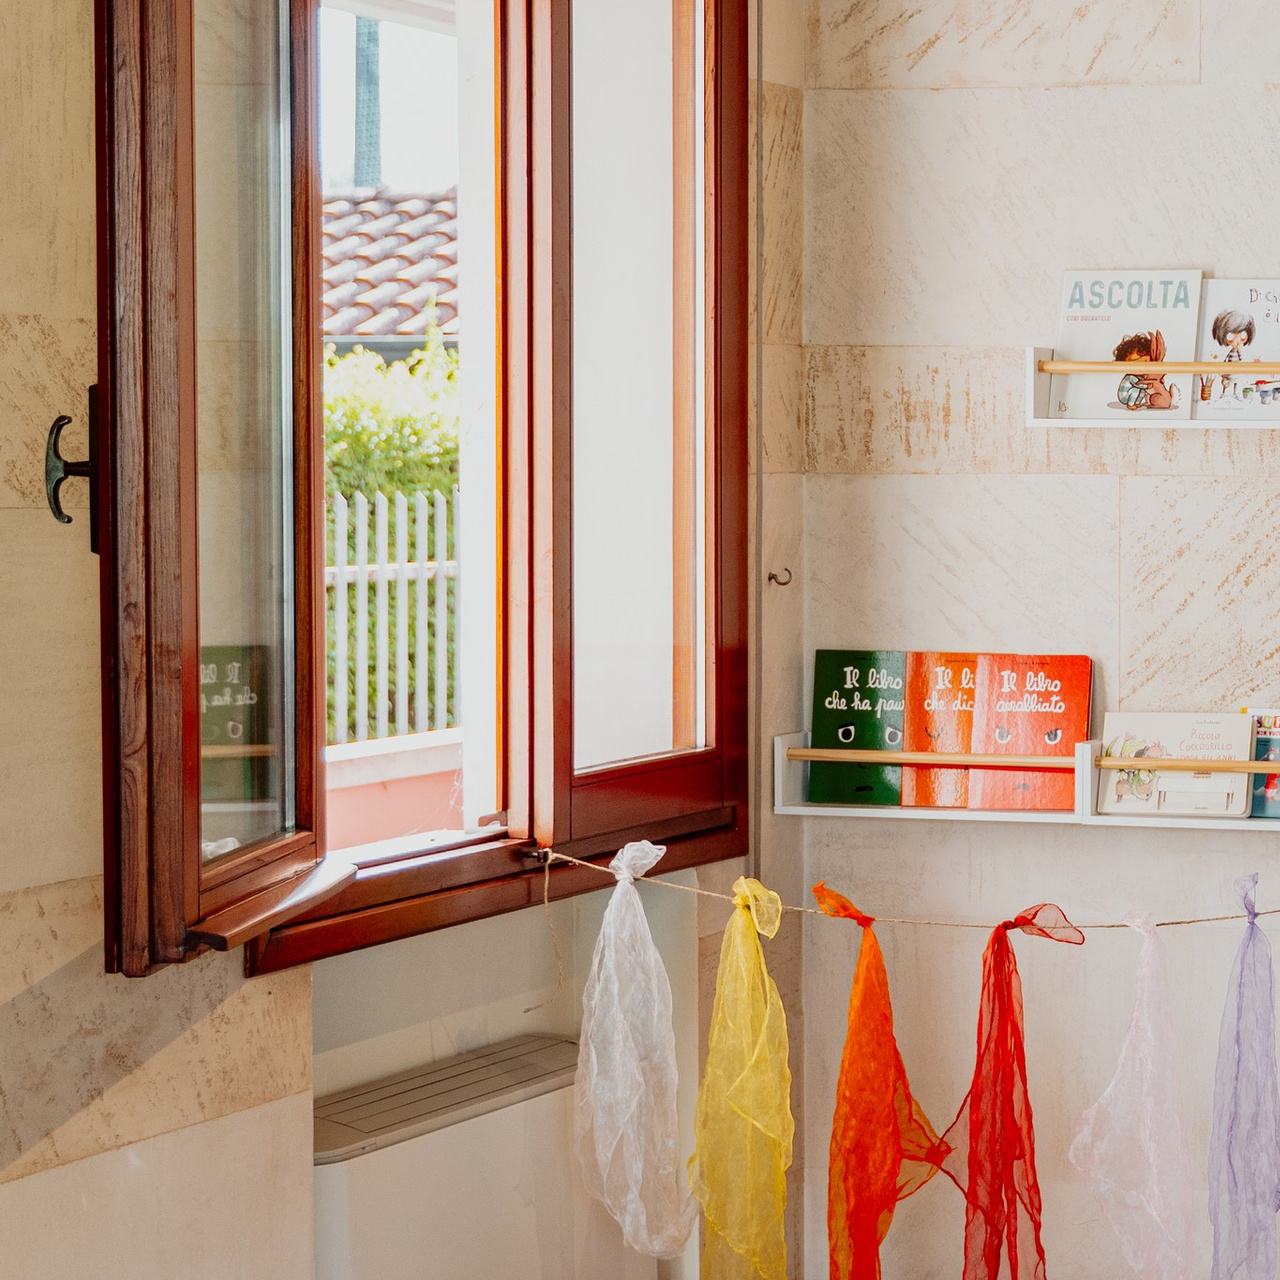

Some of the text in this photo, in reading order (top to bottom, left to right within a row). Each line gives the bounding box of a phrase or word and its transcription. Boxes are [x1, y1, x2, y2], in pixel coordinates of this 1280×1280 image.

[1067, 280, 1190, 309] ASCOLTA
[843, 666, 903, 690] Il libro
[935, 666, 976, 690] Il li
[1001, 670, 1061, 693] Il libro
[825, 690, 848, 710] che
[851, 691, 872, 711] ha
[924, 691, 975, 711] che dic
[996, 693, 1066, 713] arrabbiato
